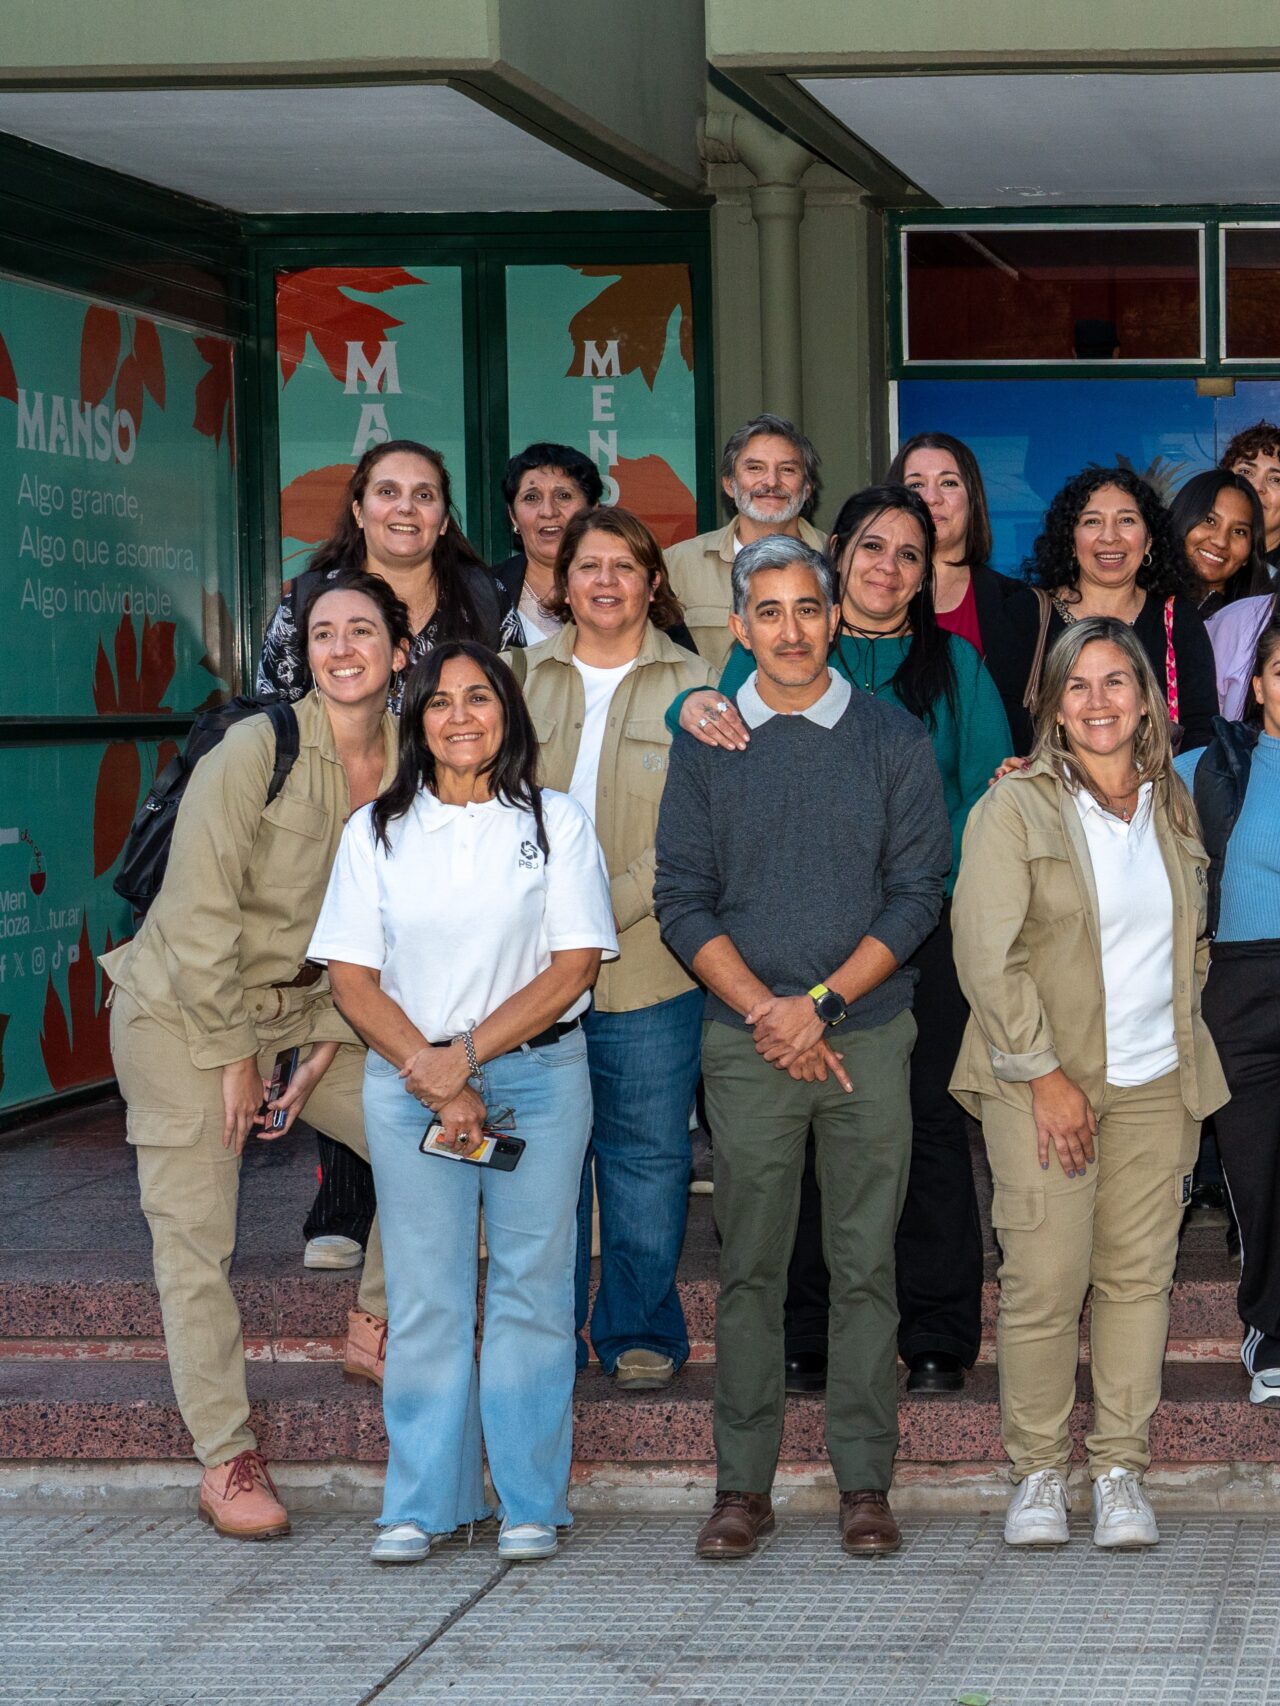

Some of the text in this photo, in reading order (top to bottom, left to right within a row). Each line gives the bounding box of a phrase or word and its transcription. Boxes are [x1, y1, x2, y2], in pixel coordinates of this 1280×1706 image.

[16, 388, 136, 465] MANSO
[343, 340, 402, 457] MA
[582, 340, 620, 508] MEND
[17, 473, 144, 525] Algo grande,
[18, 525, 199, 577] Algo que asombra,
[20, 577, 172, 619] Algo inolvidable
